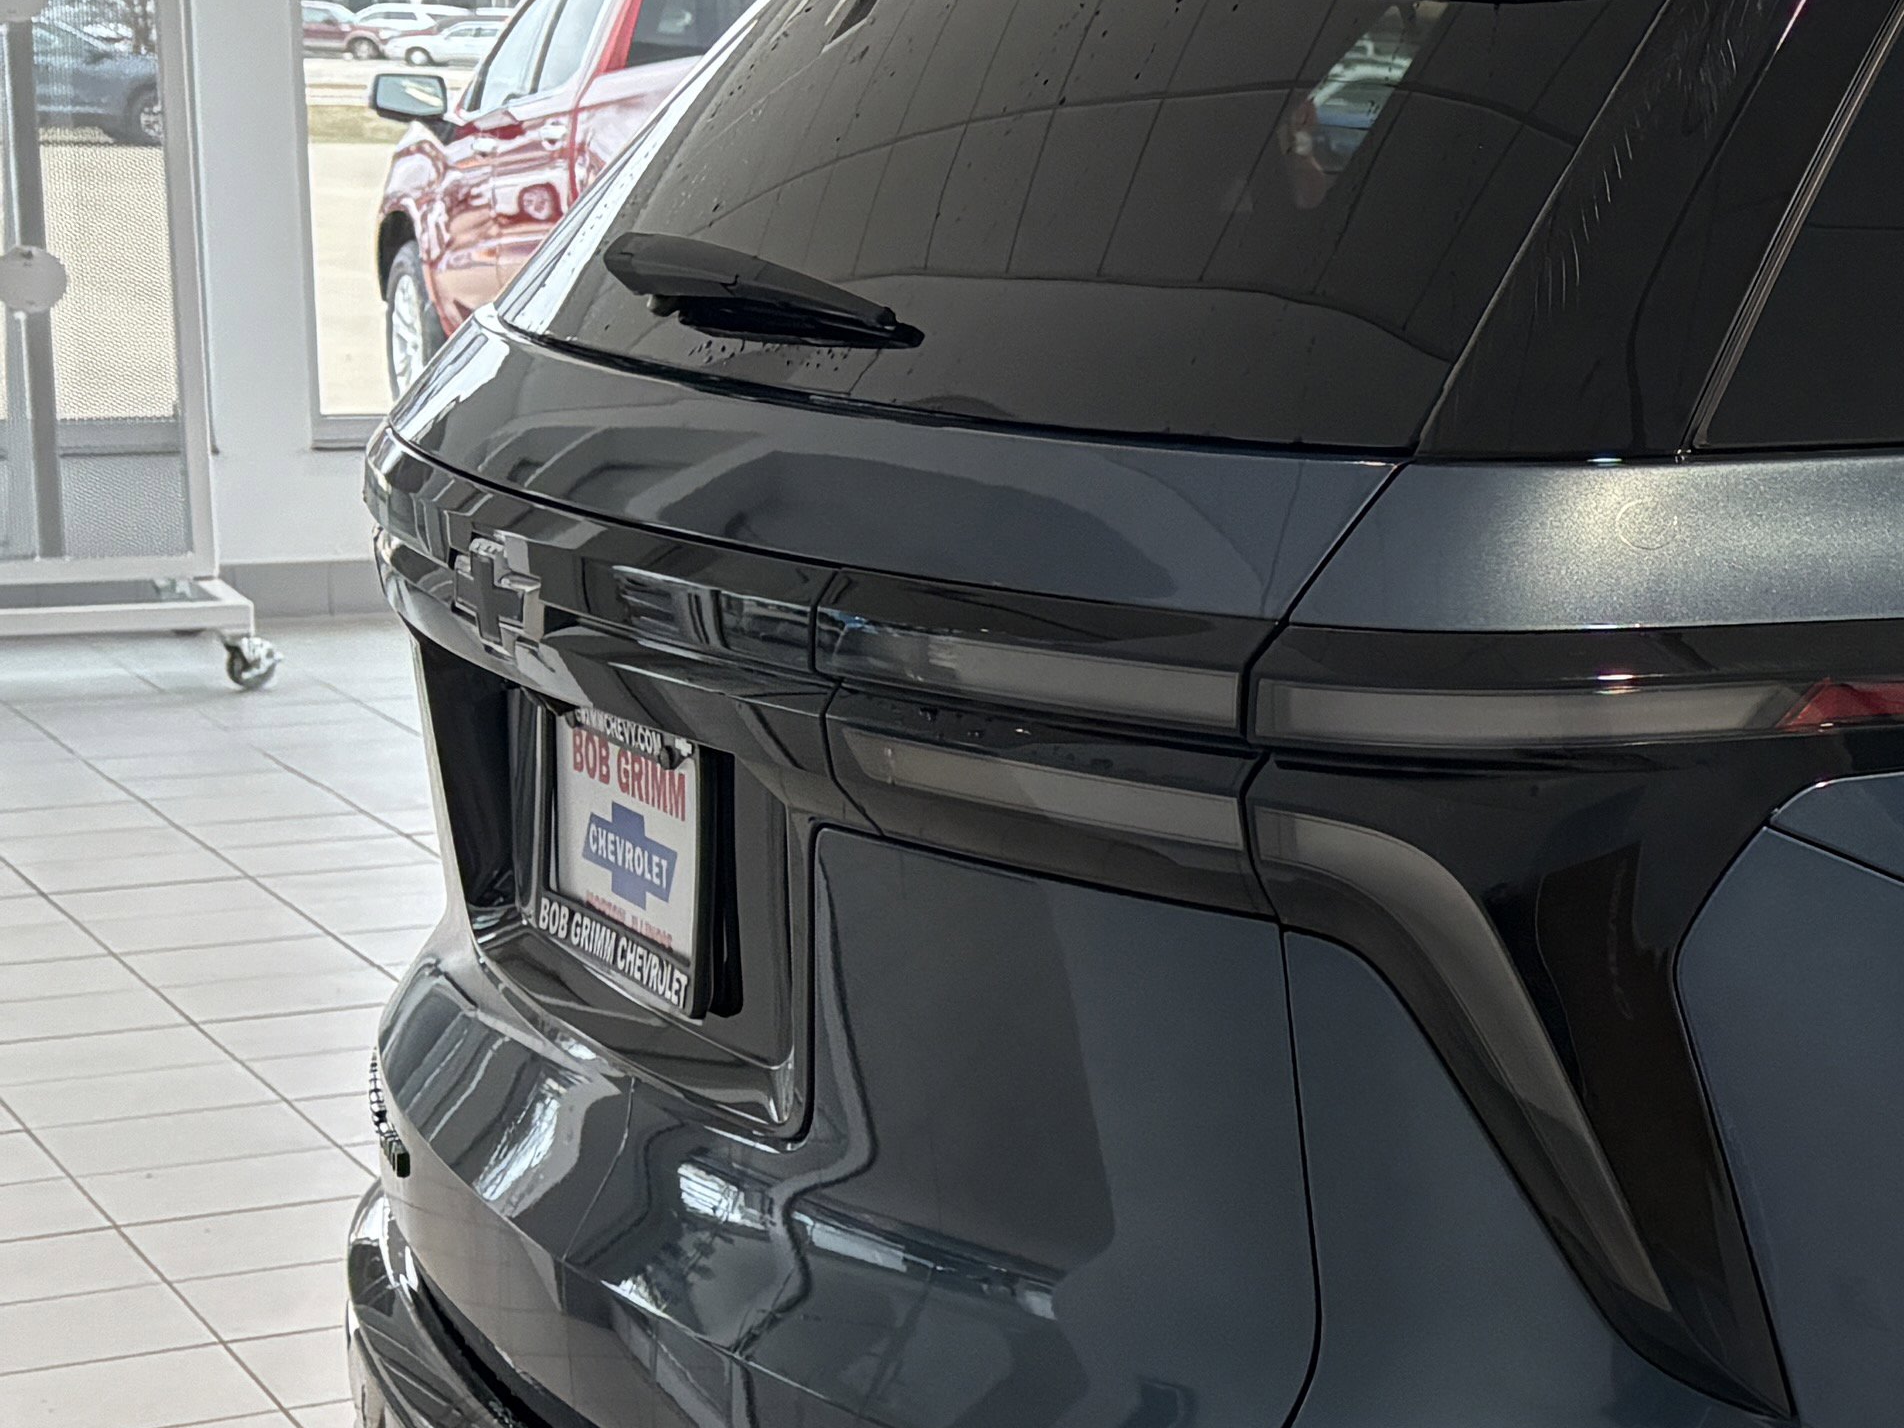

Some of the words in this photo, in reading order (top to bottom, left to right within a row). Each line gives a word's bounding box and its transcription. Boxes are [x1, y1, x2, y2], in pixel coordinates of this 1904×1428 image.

[572, 729, 610, 785] BOB
[617, 750, 686, 821] GRIMM
[589, 822, 669, 889] CHEVROLET
[539, 897, 568, 939] BOB
[571, 917, 615, 966] GRIMM
[617, 936, 687, 1008] CHEVROLET
